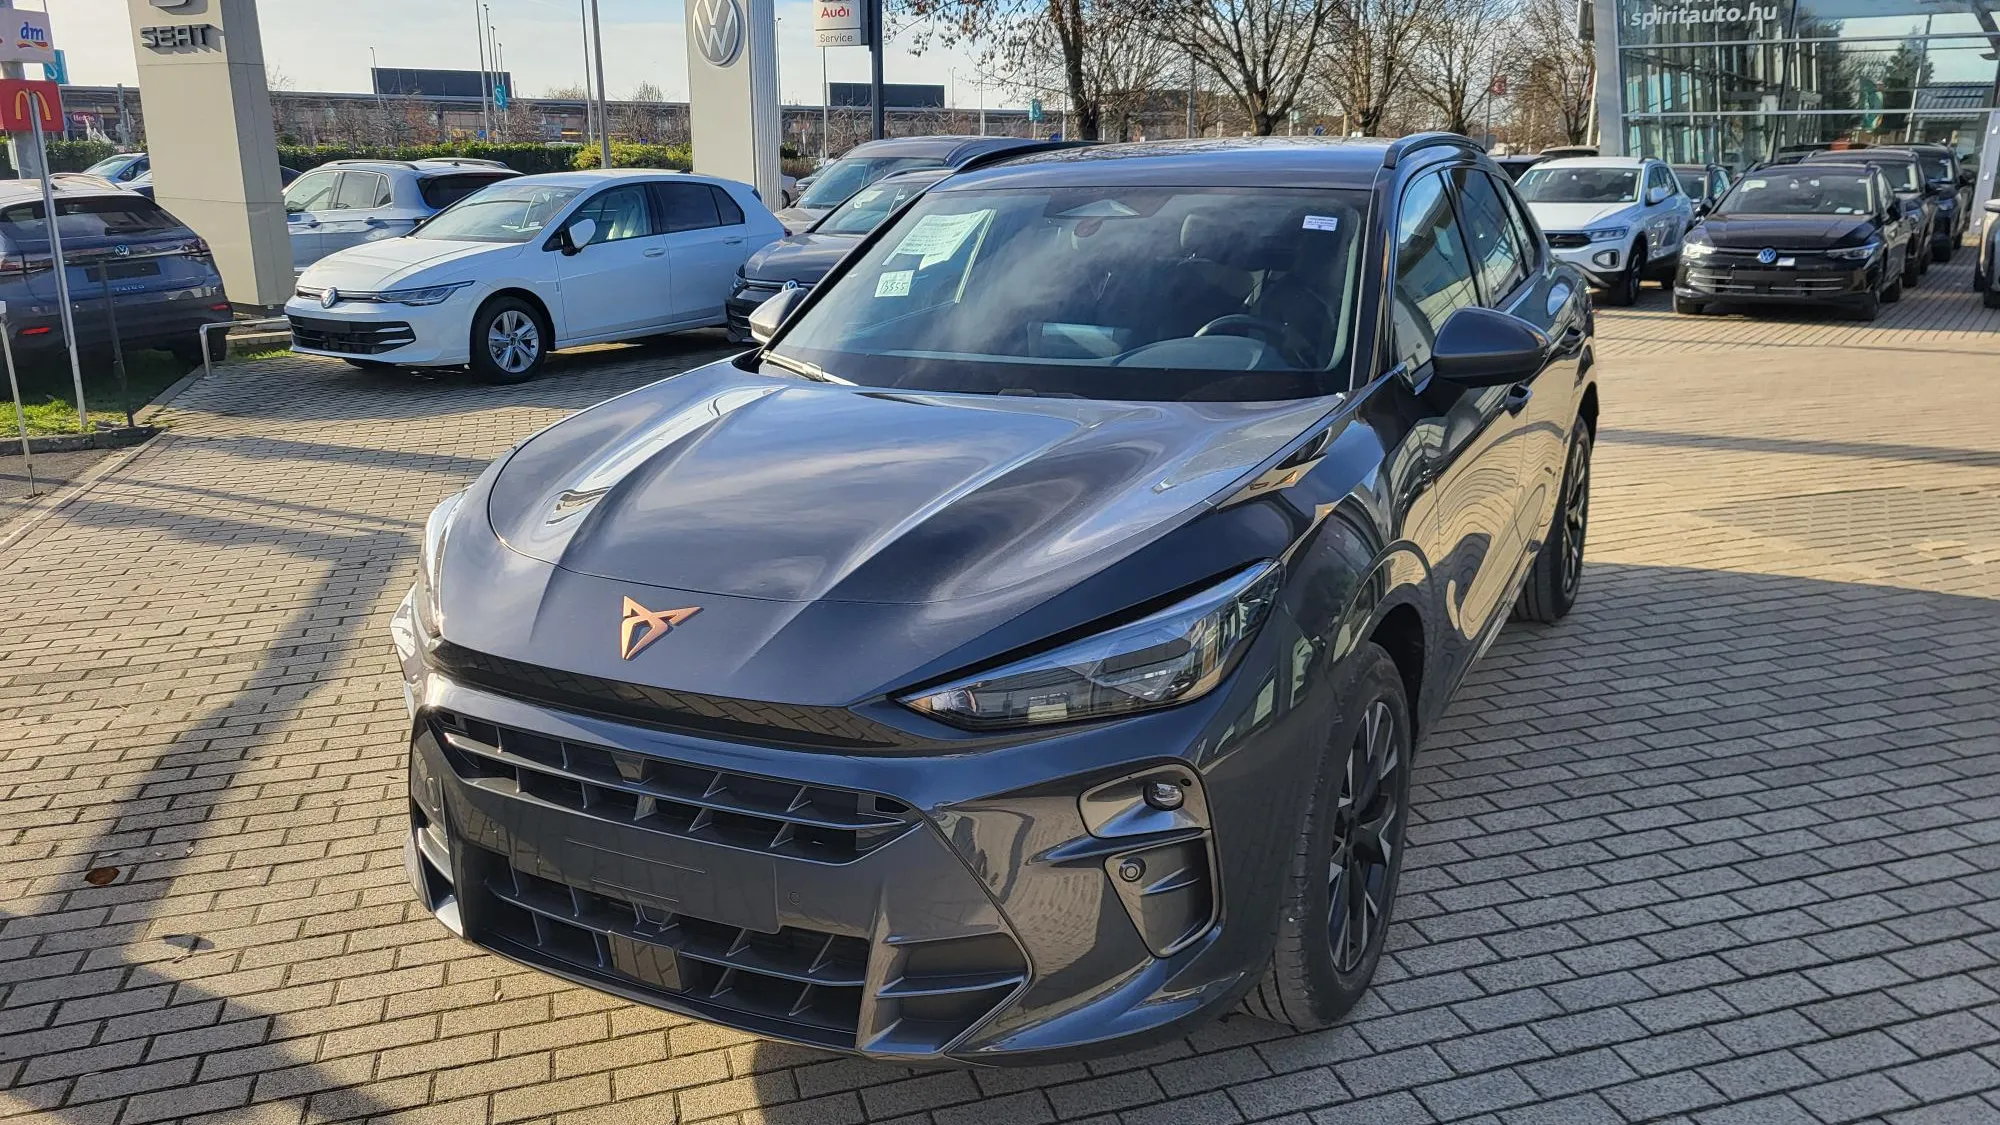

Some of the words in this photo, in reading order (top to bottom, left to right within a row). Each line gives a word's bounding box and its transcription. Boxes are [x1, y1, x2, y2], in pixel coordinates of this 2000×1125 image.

[821, 6, 850, 18] Audi
[1631, 4, 1777, 29] spiritauto.hu
[20, 21, 44, 40] dm
[141, 24, 207, 48] SEAT
[820, 33, 853, 42] Service
